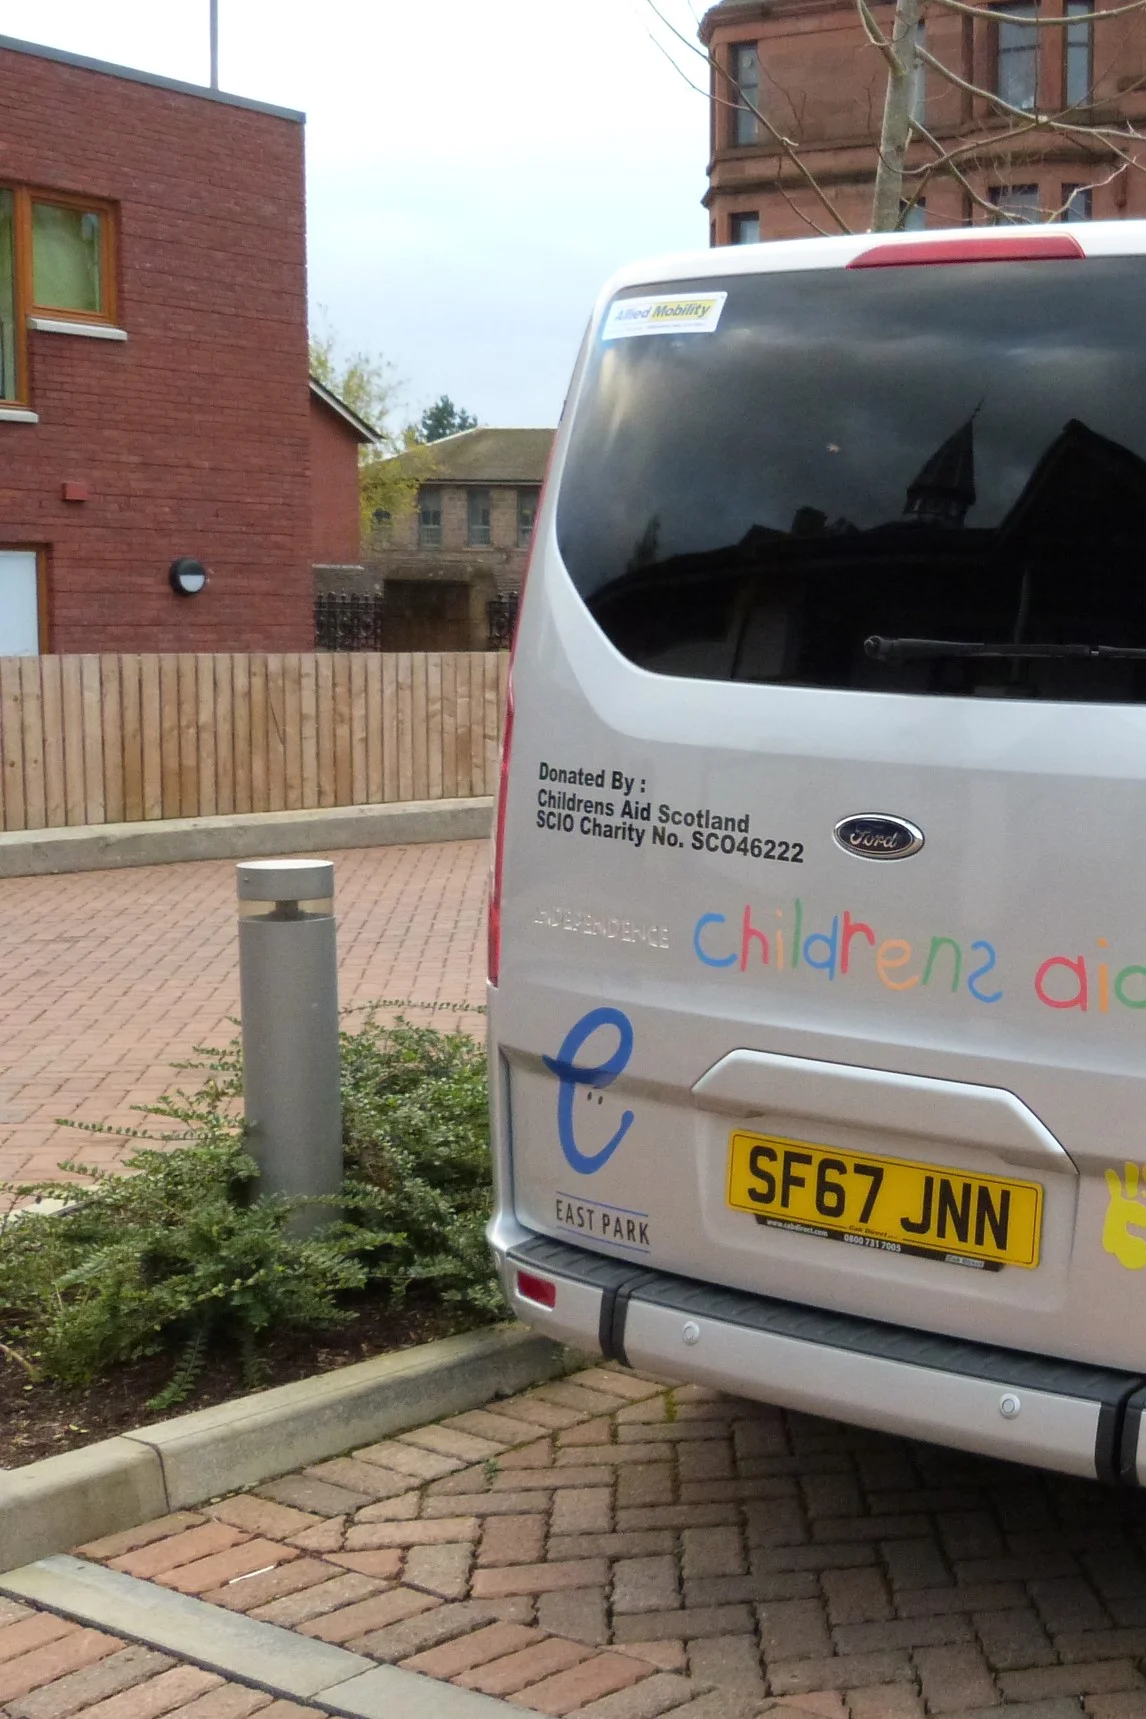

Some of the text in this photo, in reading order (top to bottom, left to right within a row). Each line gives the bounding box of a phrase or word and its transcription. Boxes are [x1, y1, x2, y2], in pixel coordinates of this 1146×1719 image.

[615, 304, 711, 320] Allied Mobility
[539, 761, 605, 788] Donated
[611, 771, 634, 796] By
[537, 788, 750, 834] Childrens Aid Scotland
[536, 810, 574, 832] SCIO
[580, 816, 645, 847] Charity
[652, 825, 684, 848] No.
[850, 827, 898, 849] Ford
[747, 1145, 1009, 1251] SF67 JNN
[556, 1199, 651, 1245] EAST PARK
[766, 1219, 828, 1237] www.cabdirect.com
[843, 1234, 864, 1246] 0800
